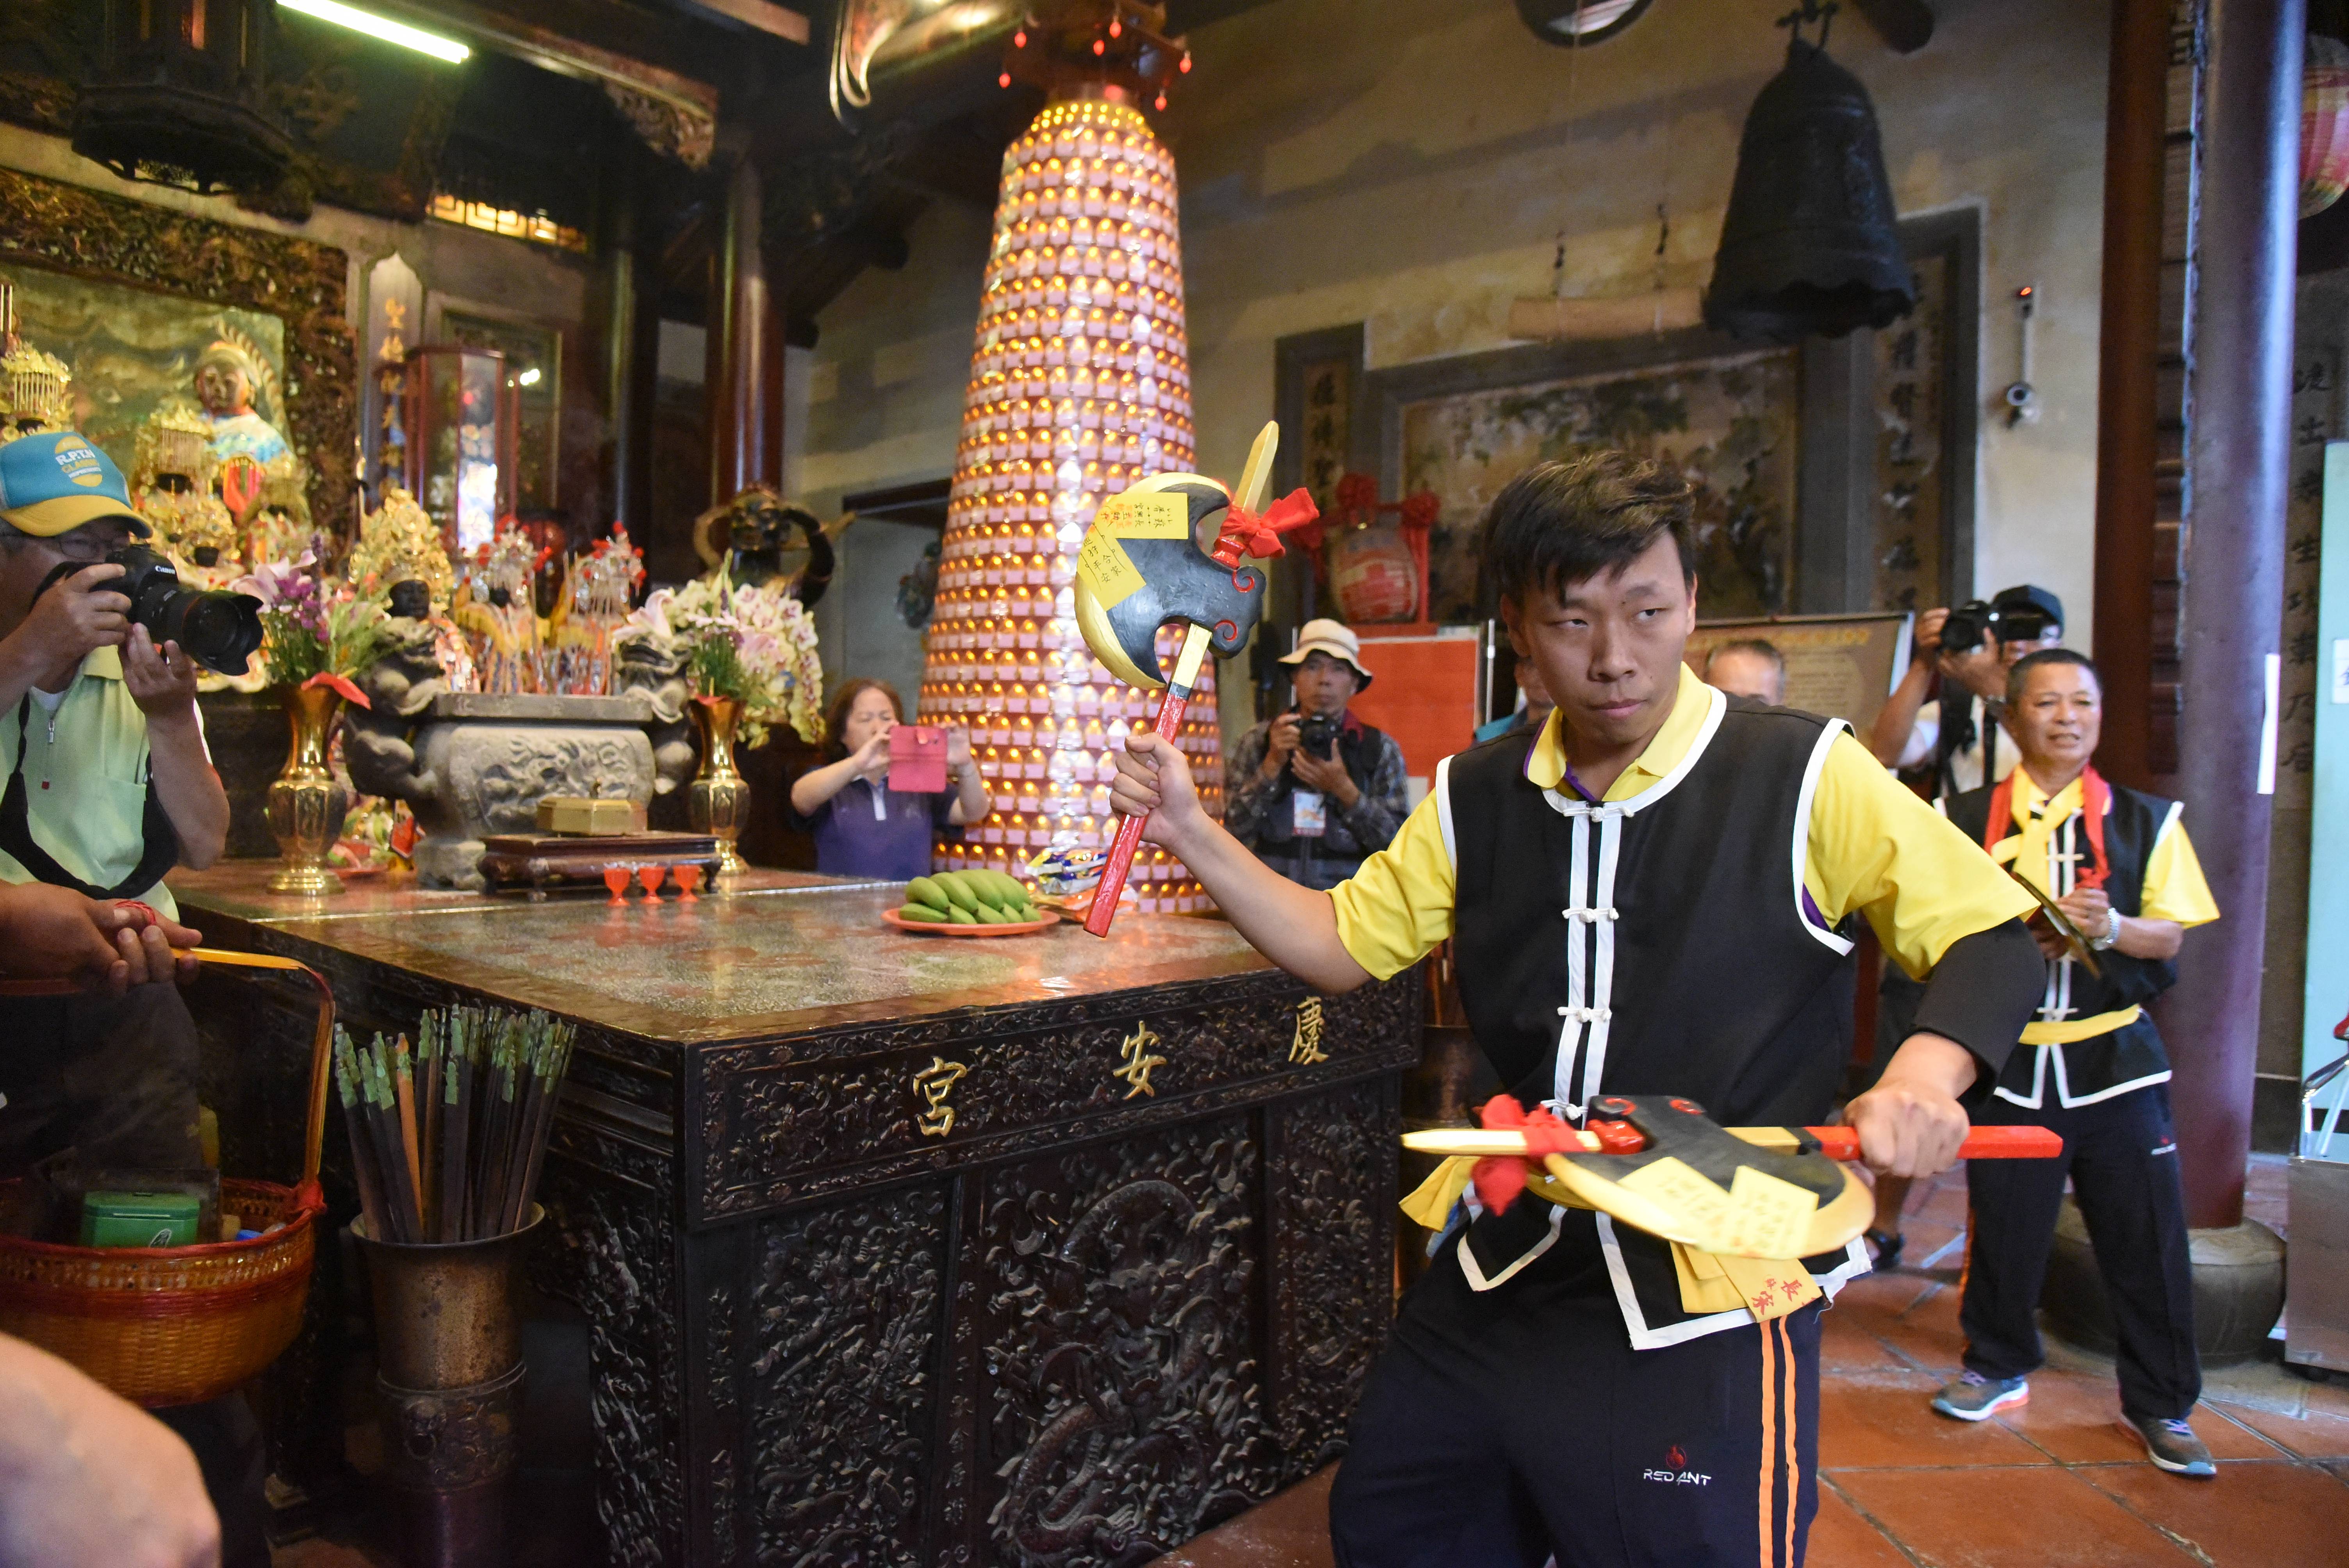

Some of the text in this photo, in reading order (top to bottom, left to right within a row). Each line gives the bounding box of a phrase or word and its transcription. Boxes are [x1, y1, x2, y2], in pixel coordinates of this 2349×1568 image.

[155, 565, 176, 575] Canon
[1643, 1468, 1712, 1486] RED ANT
